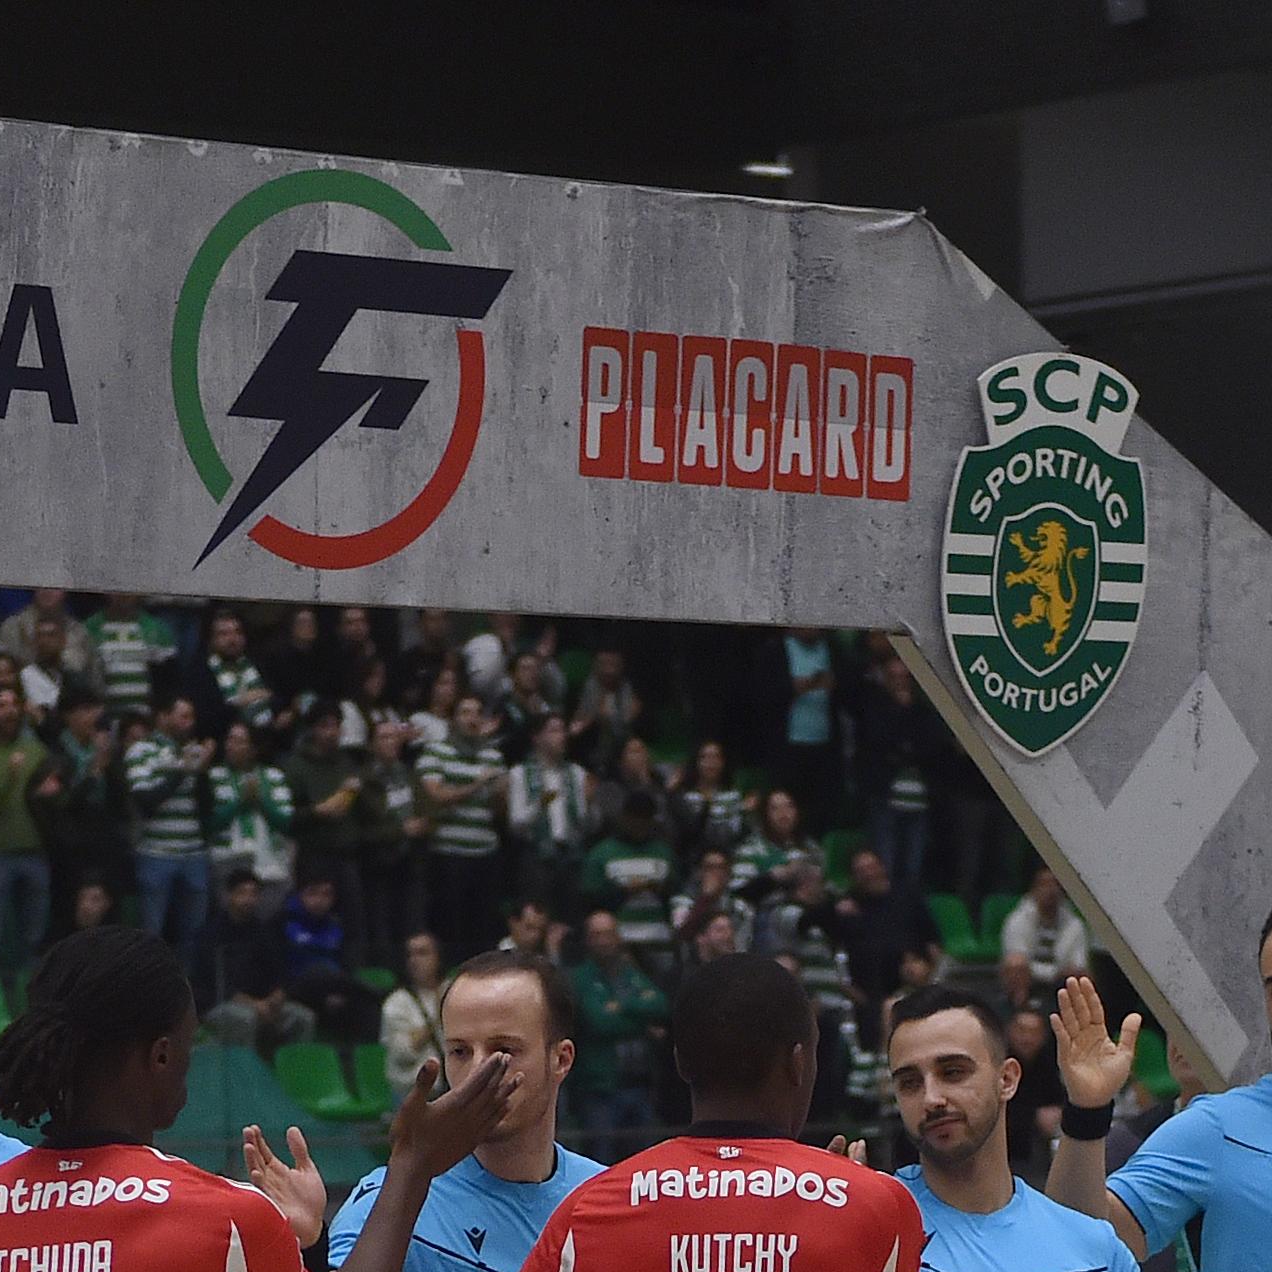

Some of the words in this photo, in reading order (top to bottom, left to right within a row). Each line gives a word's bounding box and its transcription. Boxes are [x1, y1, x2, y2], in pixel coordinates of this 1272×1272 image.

[586, 345, 907, 484] PLACARD
[984, 357, 1130, 426] SCP
[967, 446, 1129, 530] SPORTING
[968, 657, 1114, 713] PORTUGAL
